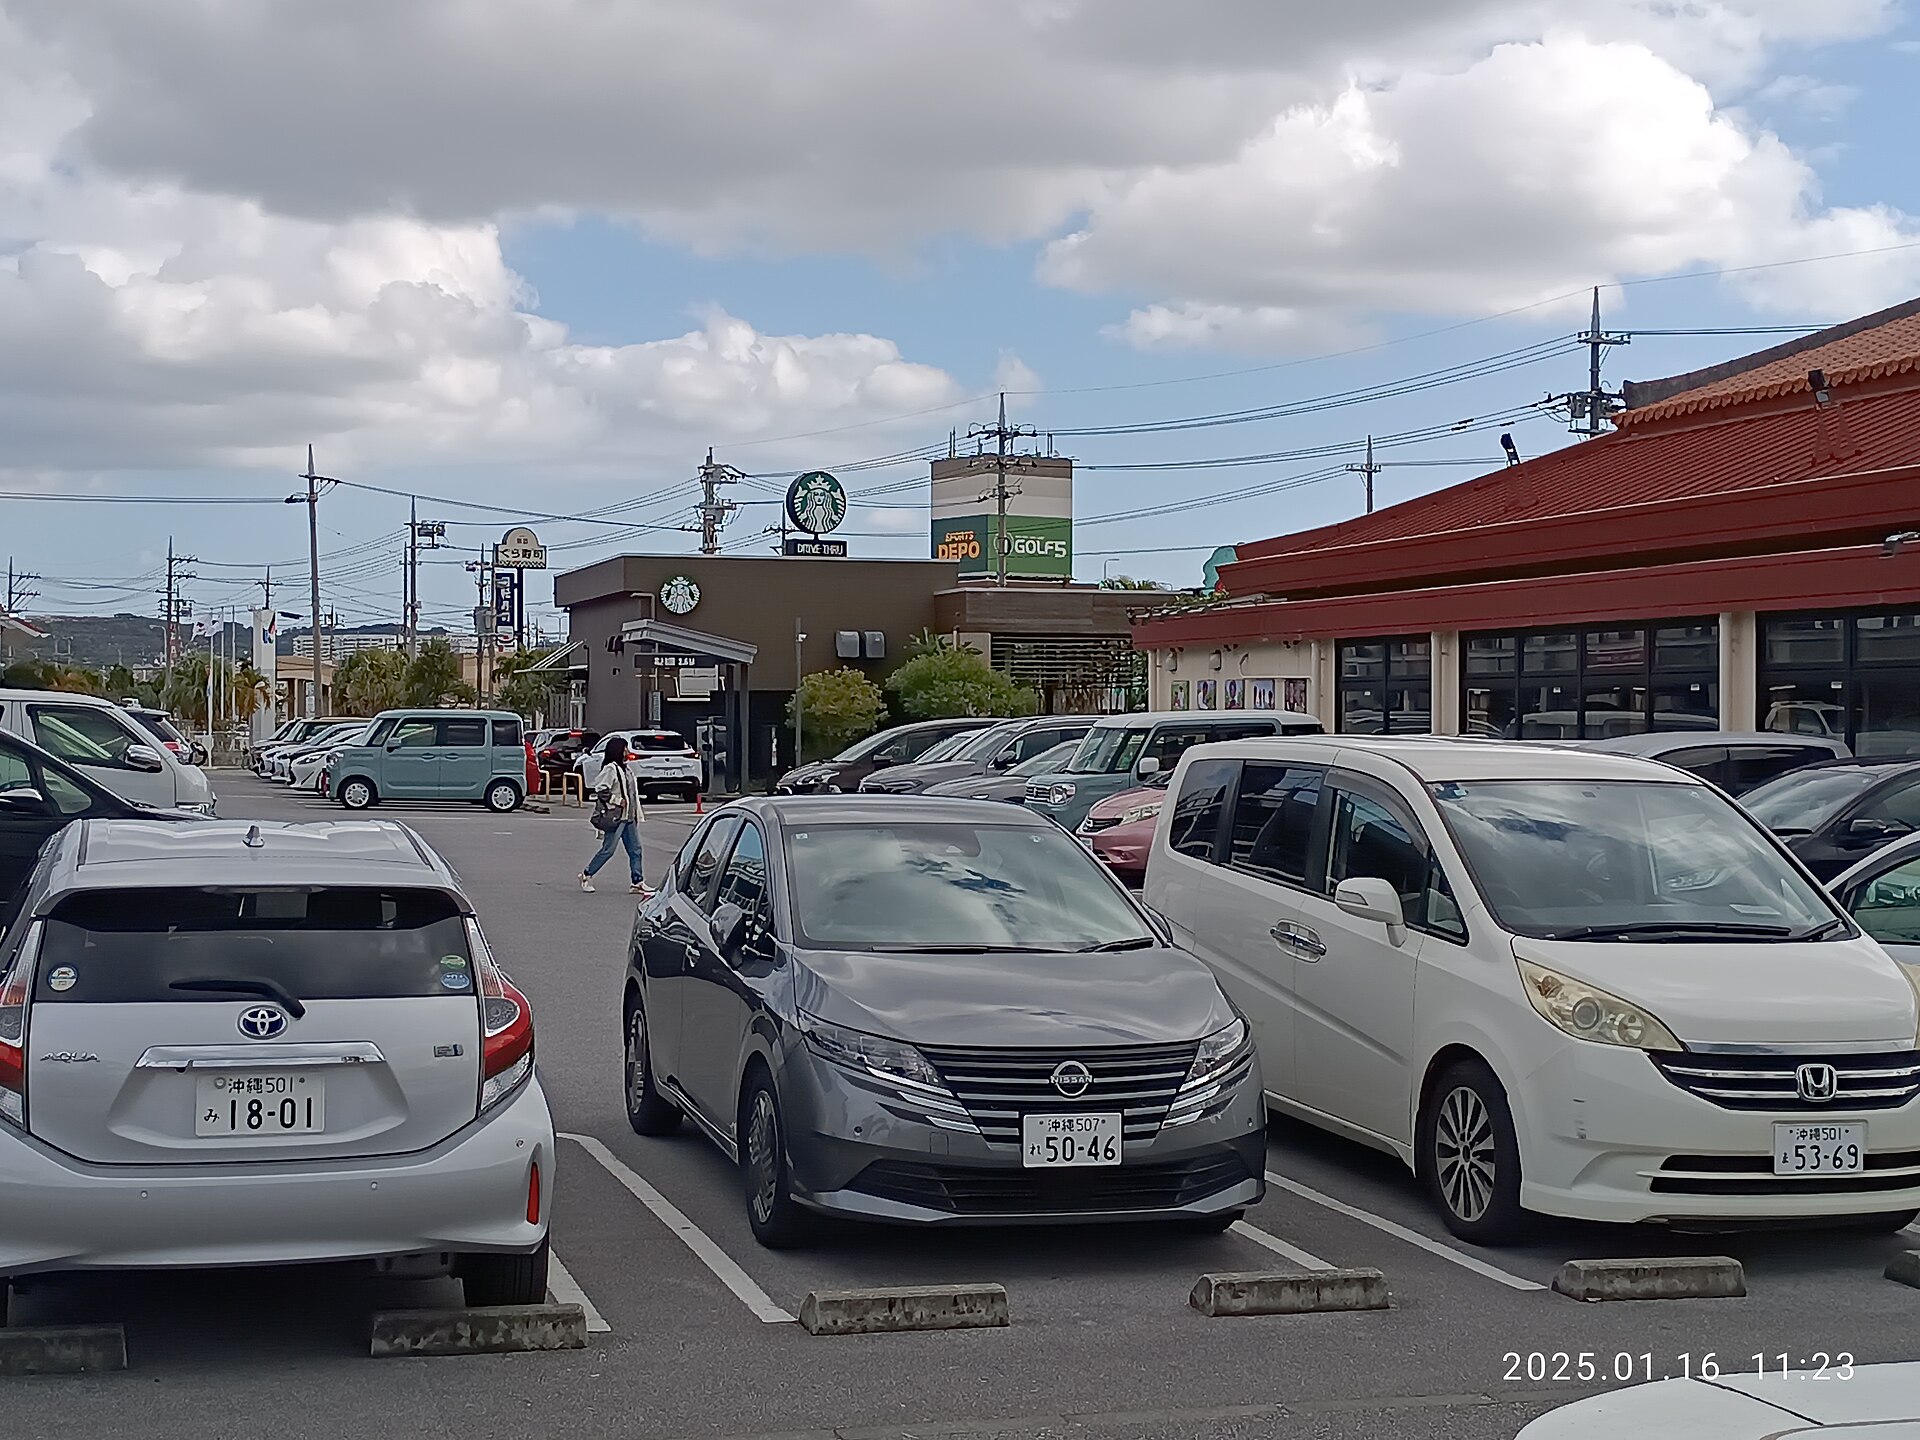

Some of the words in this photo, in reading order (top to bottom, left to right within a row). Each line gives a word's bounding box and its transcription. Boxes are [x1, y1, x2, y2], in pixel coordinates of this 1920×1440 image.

[938, 541, 980, 559] DEPO
[40, 1051, 101, 1063] AQUA
[1050, 1075, 1093, 1083] NISSAN
[203, 1108, 220, 1123] み
[230, 1097, 313, 1130] 18-01
[1045, 1135, 1117, 1162] 50-46
[1794, 1143, 1859, 1170] 53-69
